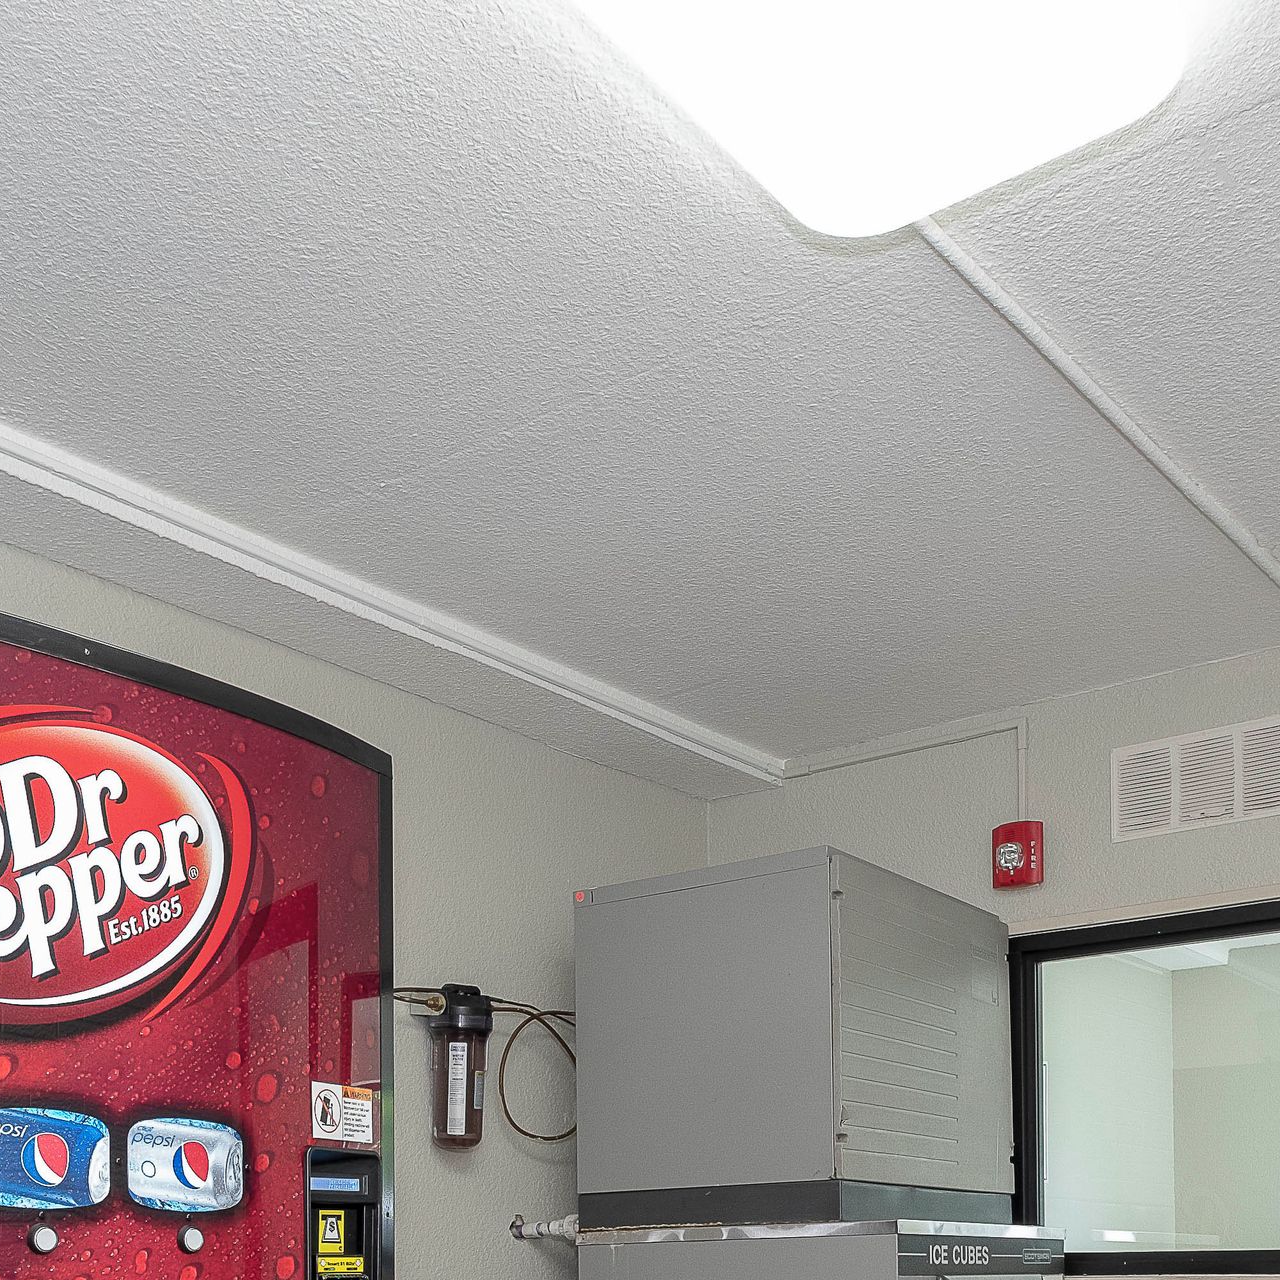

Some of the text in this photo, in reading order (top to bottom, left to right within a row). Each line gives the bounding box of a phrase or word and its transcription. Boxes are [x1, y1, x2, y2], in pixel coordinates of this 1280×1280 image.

[131, 1132, 176, 1148] pepsi
[929, 1244, 989, 1265] ICE CUBES
